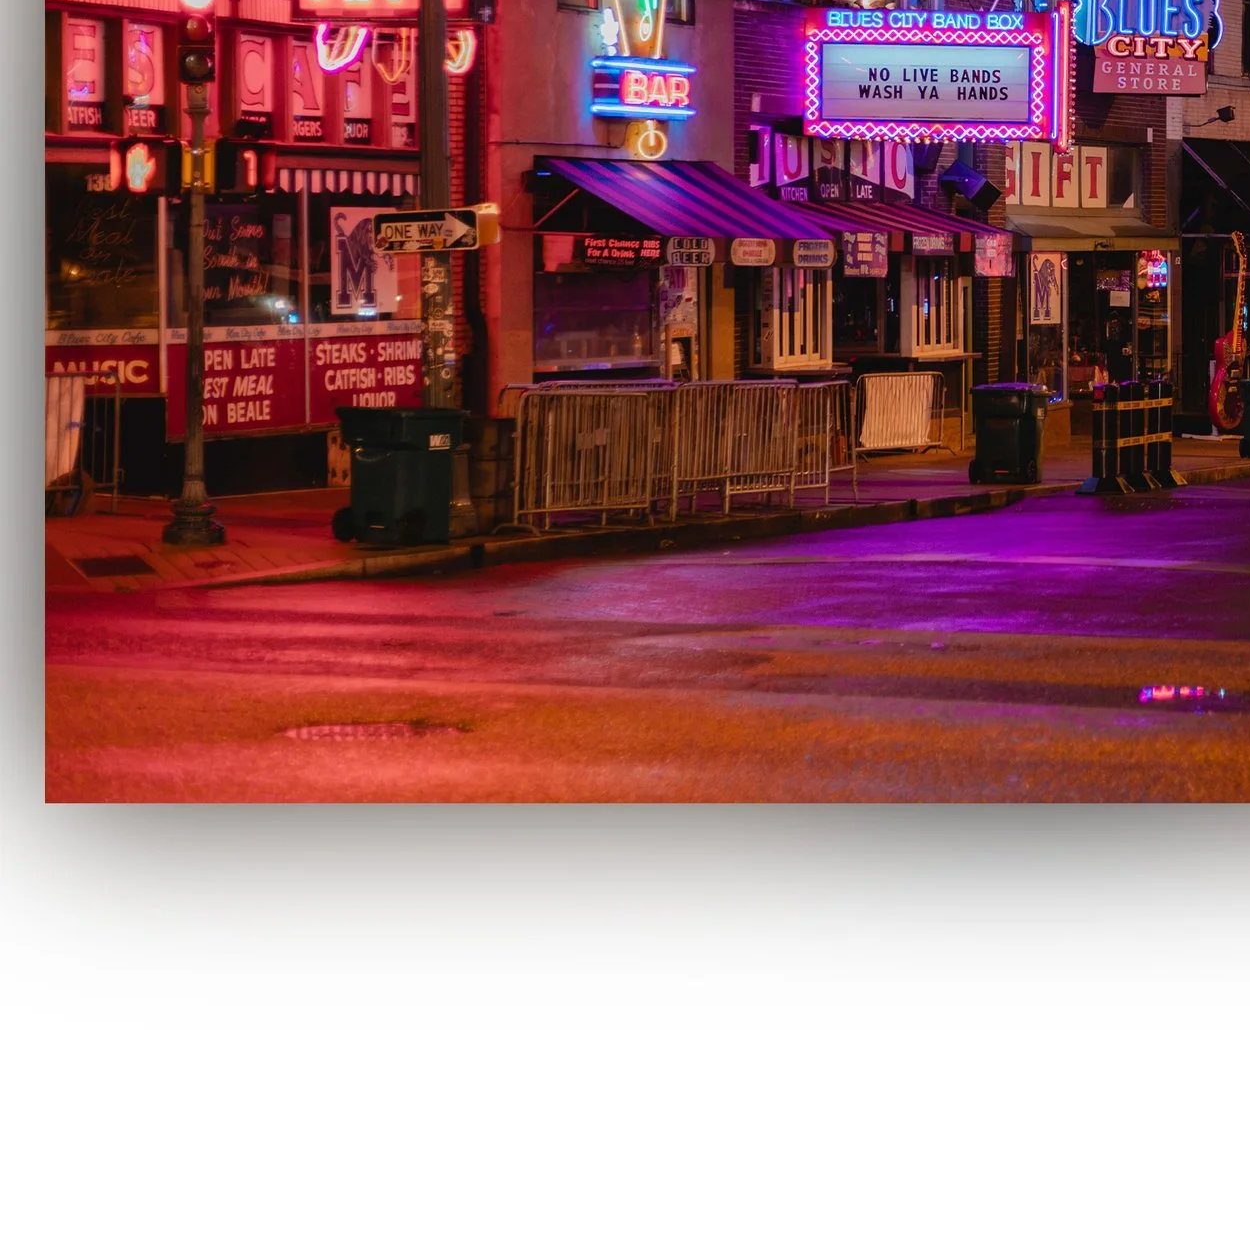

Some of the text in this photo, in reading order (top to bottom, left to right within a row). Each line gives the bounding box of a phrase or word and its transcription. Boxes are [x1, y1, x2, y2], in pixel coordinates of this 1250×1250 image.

[828, 11, 1023, 31] BLUES CITY BAND BOX
[1106, 35, 1204, 59] CITY
[868, 67, 1001, 84] NO LIVE BANDS
[1101, 61, 1197, 78] GENERAL
[621, 70, 690, 107] BAR
[858, 84, 1009, 101] WASH YA HANDS
[1117, 77, 1181, 91] STORE
[67, 106, 102, 125] ATFISH
[293, 121, 323, 138] RGERS
[781, 187, 808, 201] KITCHEN
[820, 183, 839, 198] OPEN
[856, 186, 873, 199] LATE
[384, 222, 444, 240] ONE WAY
[674, 238, 709, 249] COLD
[672, 251, 710, 263] BEER
[798, 254, 828, 264] DRINKS
[204, 347, 276, 371] PEN LATE
[315, 342, 367, 366] STEAKS
[203, 374, 275, 399] EST MEAL
[324, 365, 416, 391] CATFISH RIBS
[227, 400, 271, 423] BEALE
